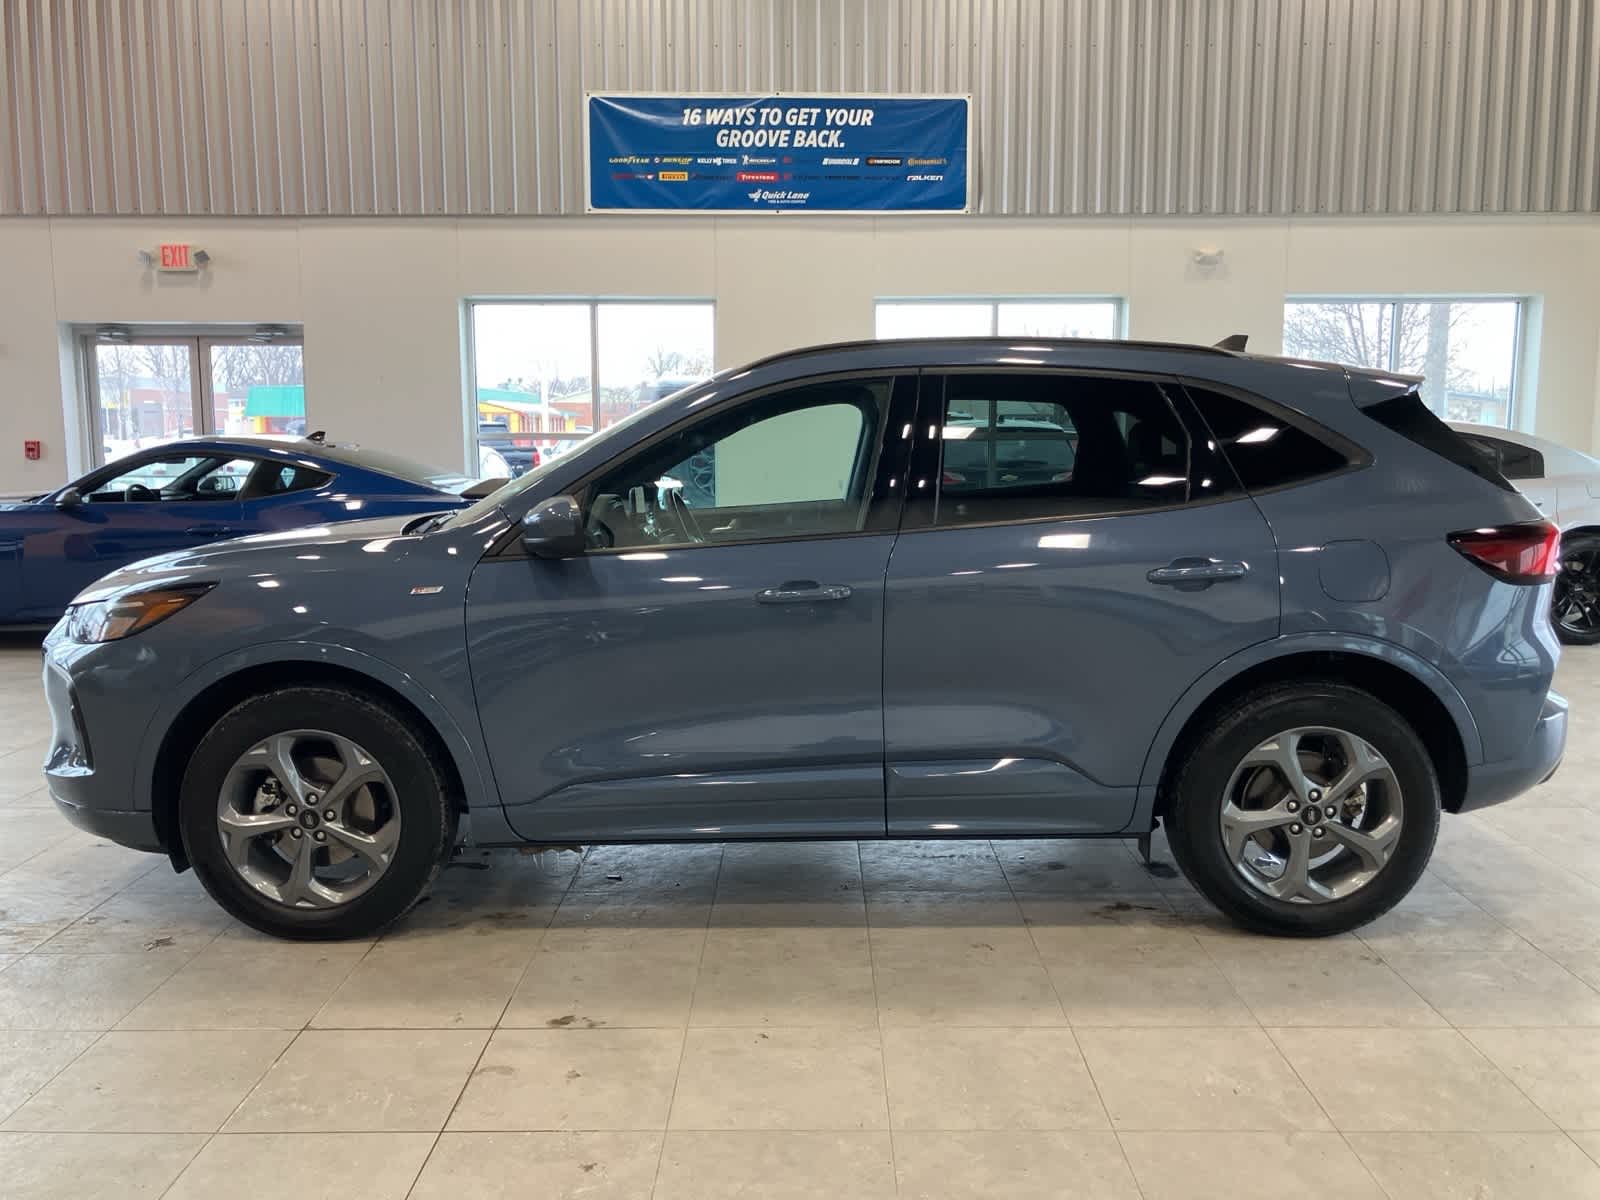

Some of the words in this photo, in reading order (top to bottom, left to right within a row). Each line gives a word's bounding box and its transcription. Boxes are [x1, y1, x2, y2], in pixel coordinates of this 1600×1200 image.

[682, 108, 702, 126] 16
[705, 107, 757, 126] WAYS
[759, 107, 782, 126] TO
[785, 107, 821, 126] GET
[825, 108, 874, 126] YOUR
[716, 129, 791, 148] GROOVE
[793, 129, 845, 148] BACK.
[761, 191, 787, 200] Quick
[787, 191, 810, 200] Lane
[160, 244, 189, 268] EXIT
